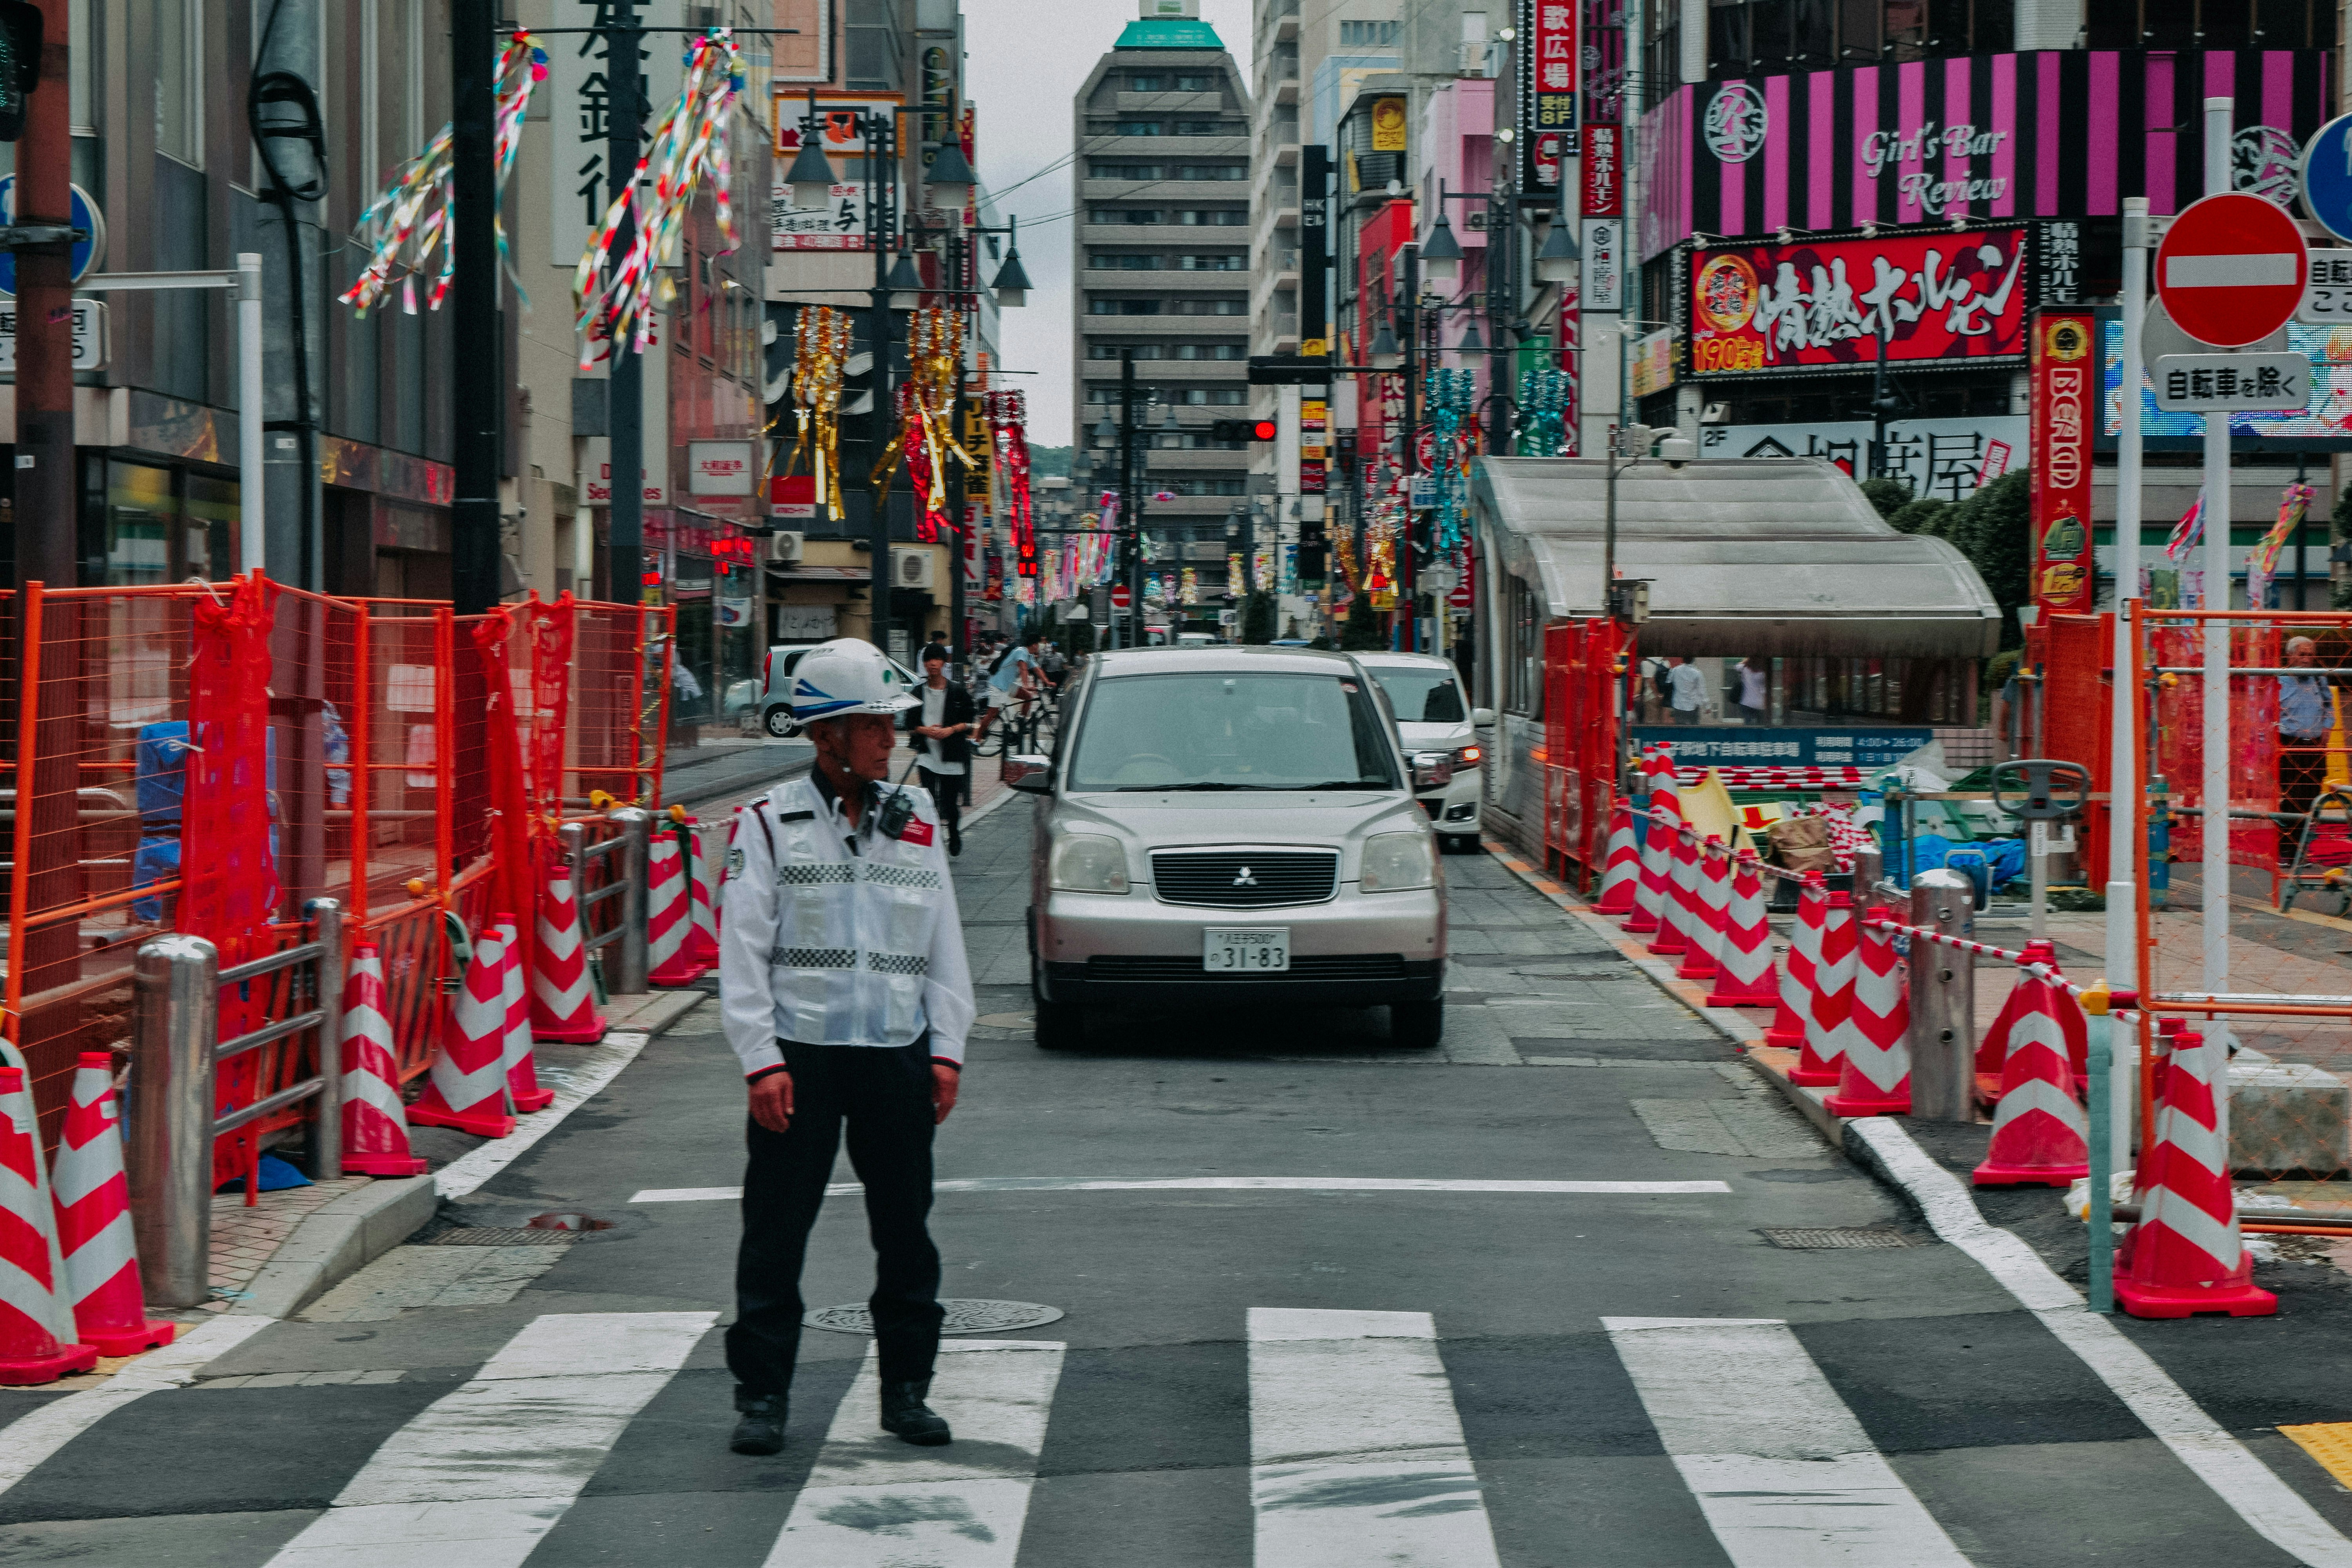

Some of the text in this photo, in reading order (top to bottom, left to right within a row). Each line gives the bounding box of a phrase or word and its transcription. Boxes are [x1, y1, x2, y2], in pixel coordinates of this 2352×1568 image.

[1543, 5, 1570, 88] 歌広場
[1539, 95, 1572, 110] 受付
[1540, 111, 1571, 124] 8F
[1861, 121, 2007, 177] Girl's Bar
[1897, 171, 2007, 215] Review
[2313, 259, 2352, 283] 自転
[1752, 241, 2025, 361] 情熱ホルモン
[2167, 366, 2296, 400] 自転車を除く
[1704, 430, 1728, 447] 2F
[1223, 947, 1285, 968] 31-83
